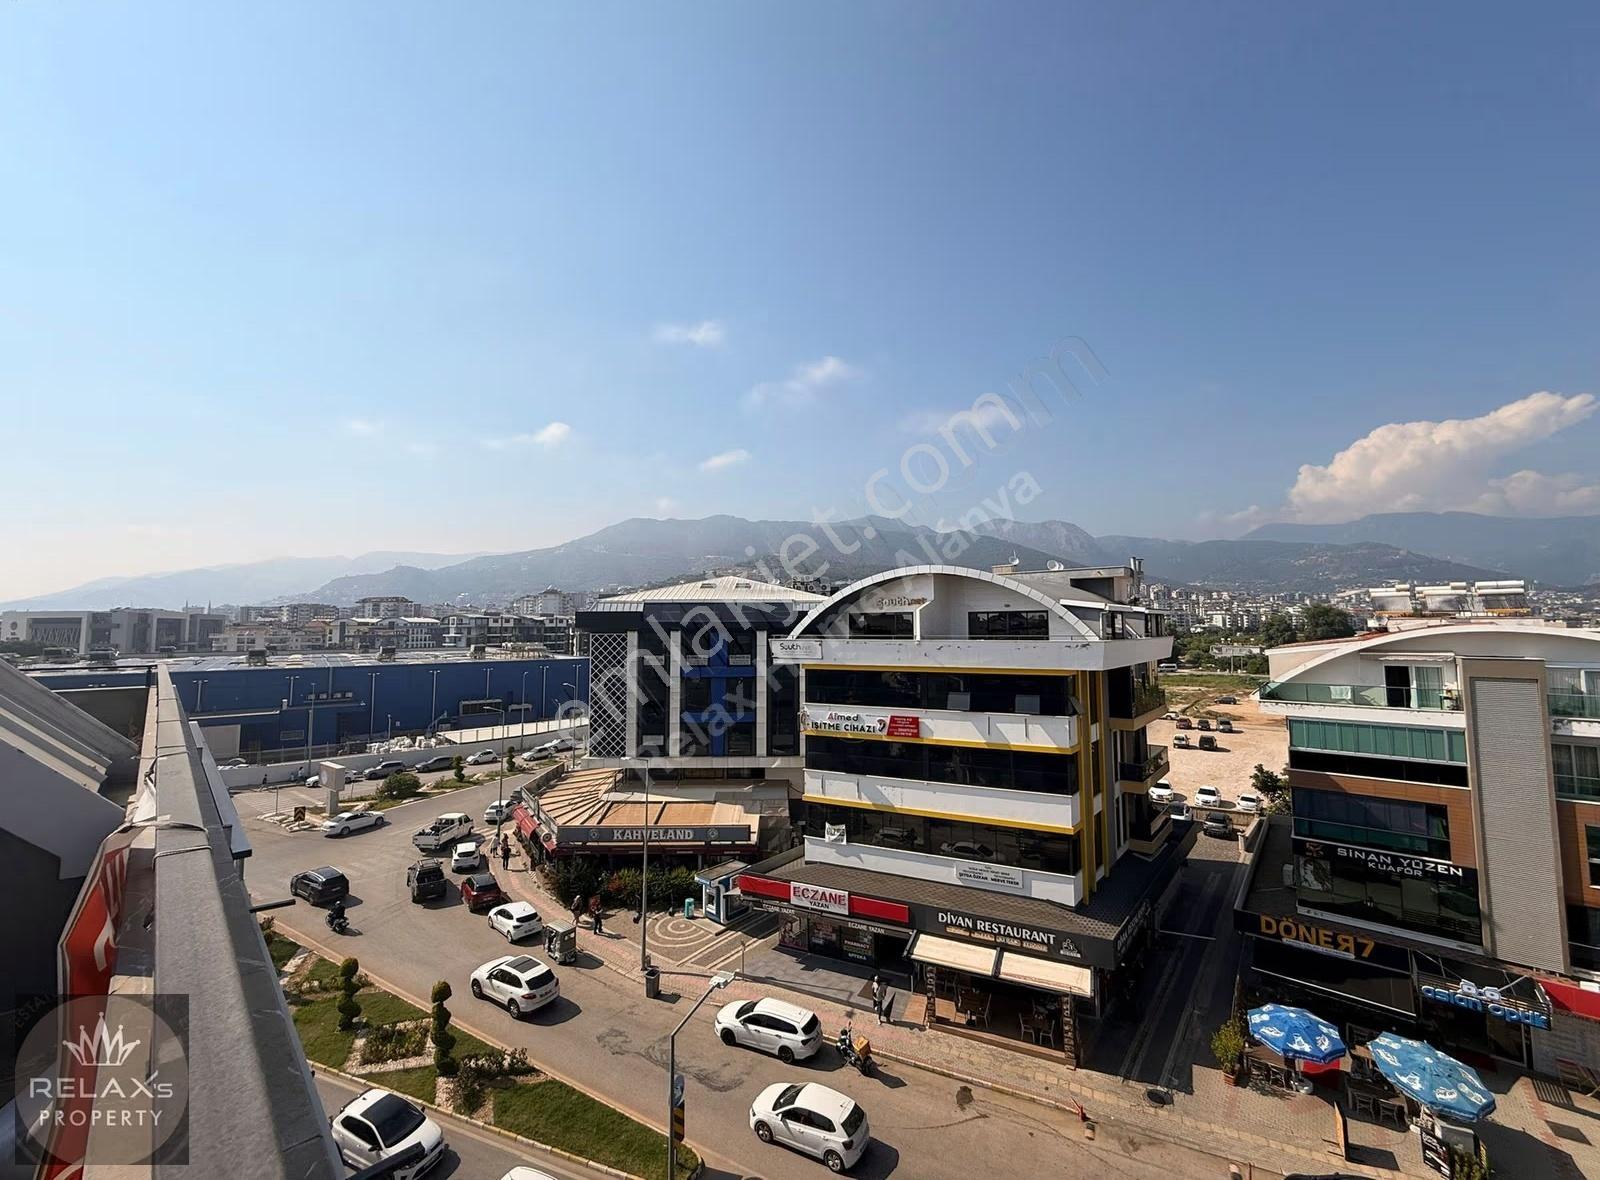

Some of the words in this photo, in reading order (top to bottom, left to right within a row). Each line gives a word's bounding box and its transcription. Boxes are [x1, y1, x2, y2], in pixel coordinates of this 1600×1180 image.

[613, 828, 695, 840] KAHVELAND
[1367, 861, 1423, 877] KUAFÖR
[1400, 858, 1463, 877] YÜZEN
[793, 886, 848, 906] ECZANE
[809, 901, 830, 910] YAZAN
[938, 912, 973, 929] DİVAN
[976, 920, 1056, 945] RESTAURANT
